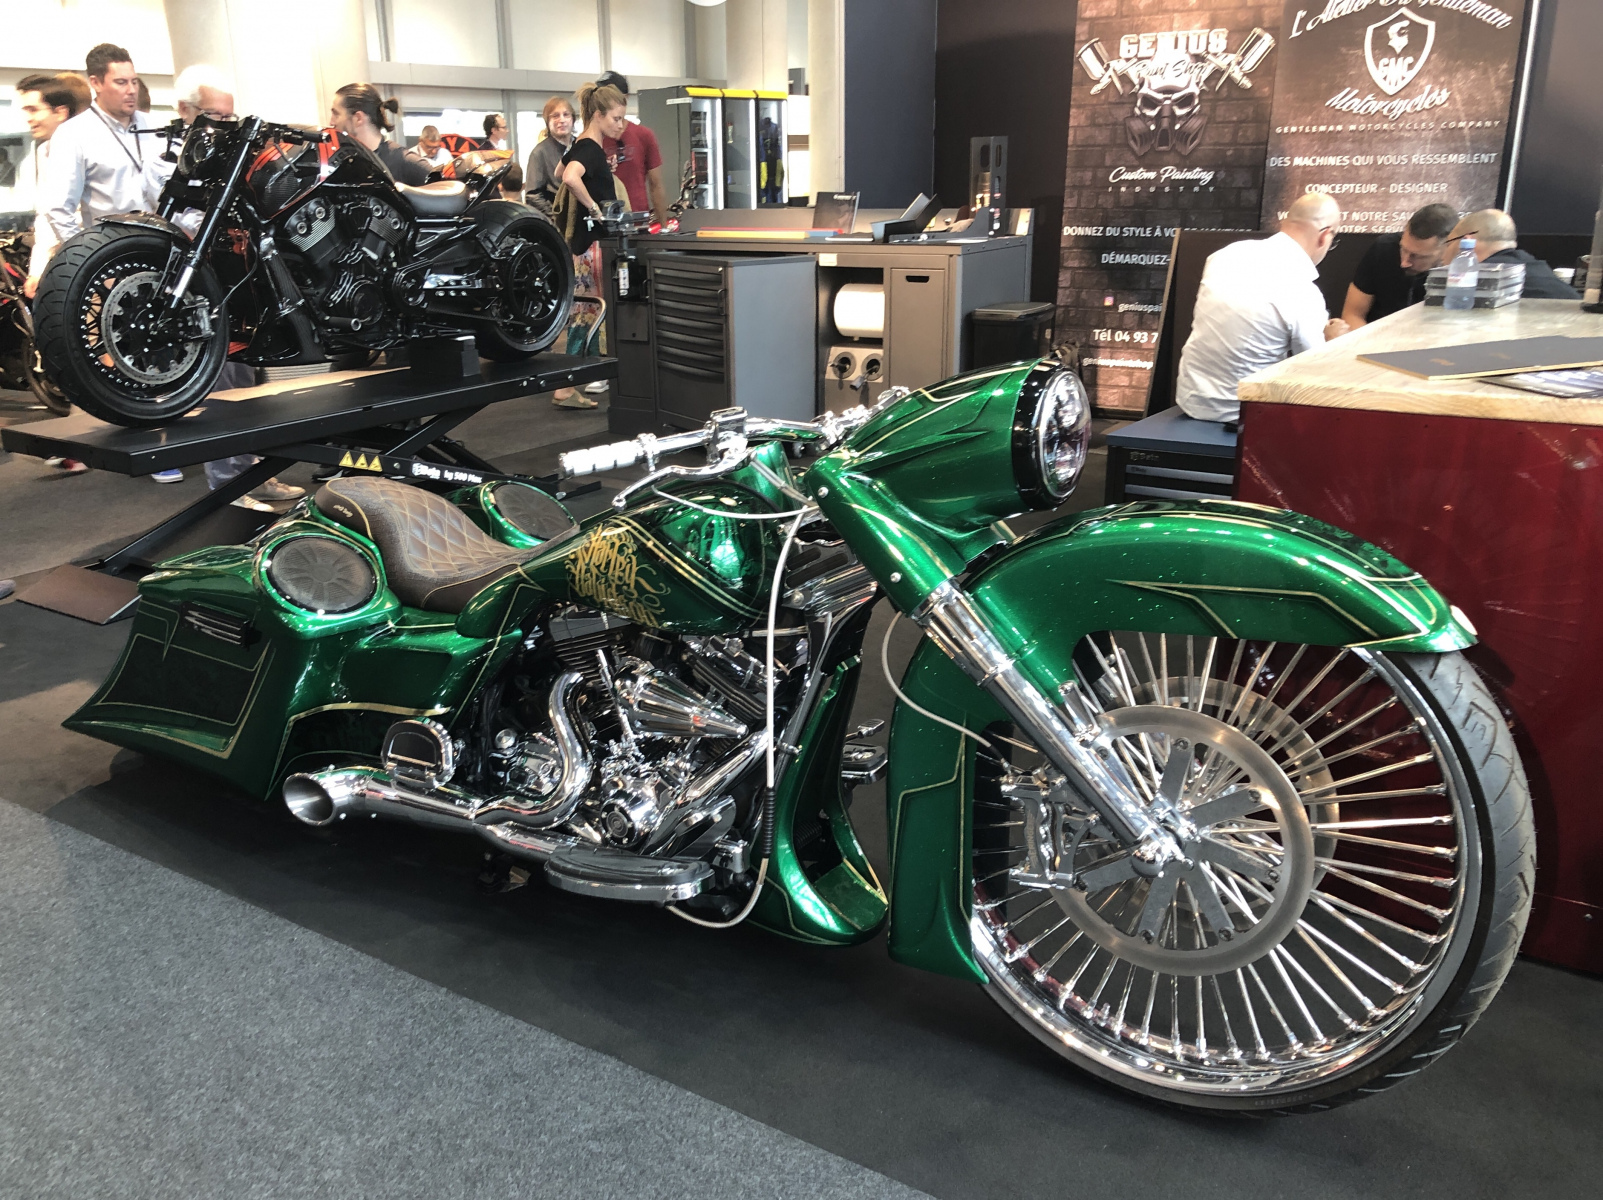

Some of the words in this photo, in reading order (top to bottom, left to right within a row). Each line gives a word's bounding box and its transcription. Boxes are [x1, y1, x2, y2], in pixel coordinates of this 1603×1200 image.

[1119, 28, 1229, 59] GENIUS
[1378, 56, 1414, 87] GMC
[1325, 84, 1450, 121] Motorcycles
[1275, 124, 1344, 134] GENTLEMAN
[1348, 121, 1435, 132] MOTORCYCLES
[1440, 120, 1501, 130] COMPANY
[1269, 157, 1291, 167] DES
[1293, 155, 1350, 167] MACHINES
[1352, 155, 1374, 166] QUI
[1376, 154, 1409, 165] VOUS
[1411, 152, 1498, 165] RESSEMBLENT
[1108, 166, 1157, 183] Custom
[1160, 165, 1215, 186] Painting
[1304, 183, 1379, 194] CONCEPTEUR
[1389, 183, 1449, 194] DESIGNER
[1351, 211, 1390, 222] NOTRE
[1063, 226, 1104, 236] DONNEZ
[1105, 227, 1121, 237] DU
[1122, 227, 1152, 237] STYLE
[1153, 226, 1162, 237] À
[1118, 302, 1163, 313] geniuspai
[1093, 328, 1112, 341] Tél
[1114, 330, 1131, 342] 04
[1133, 331, 1149, 344] 93
[1150, 332, 1159, 344] 7
